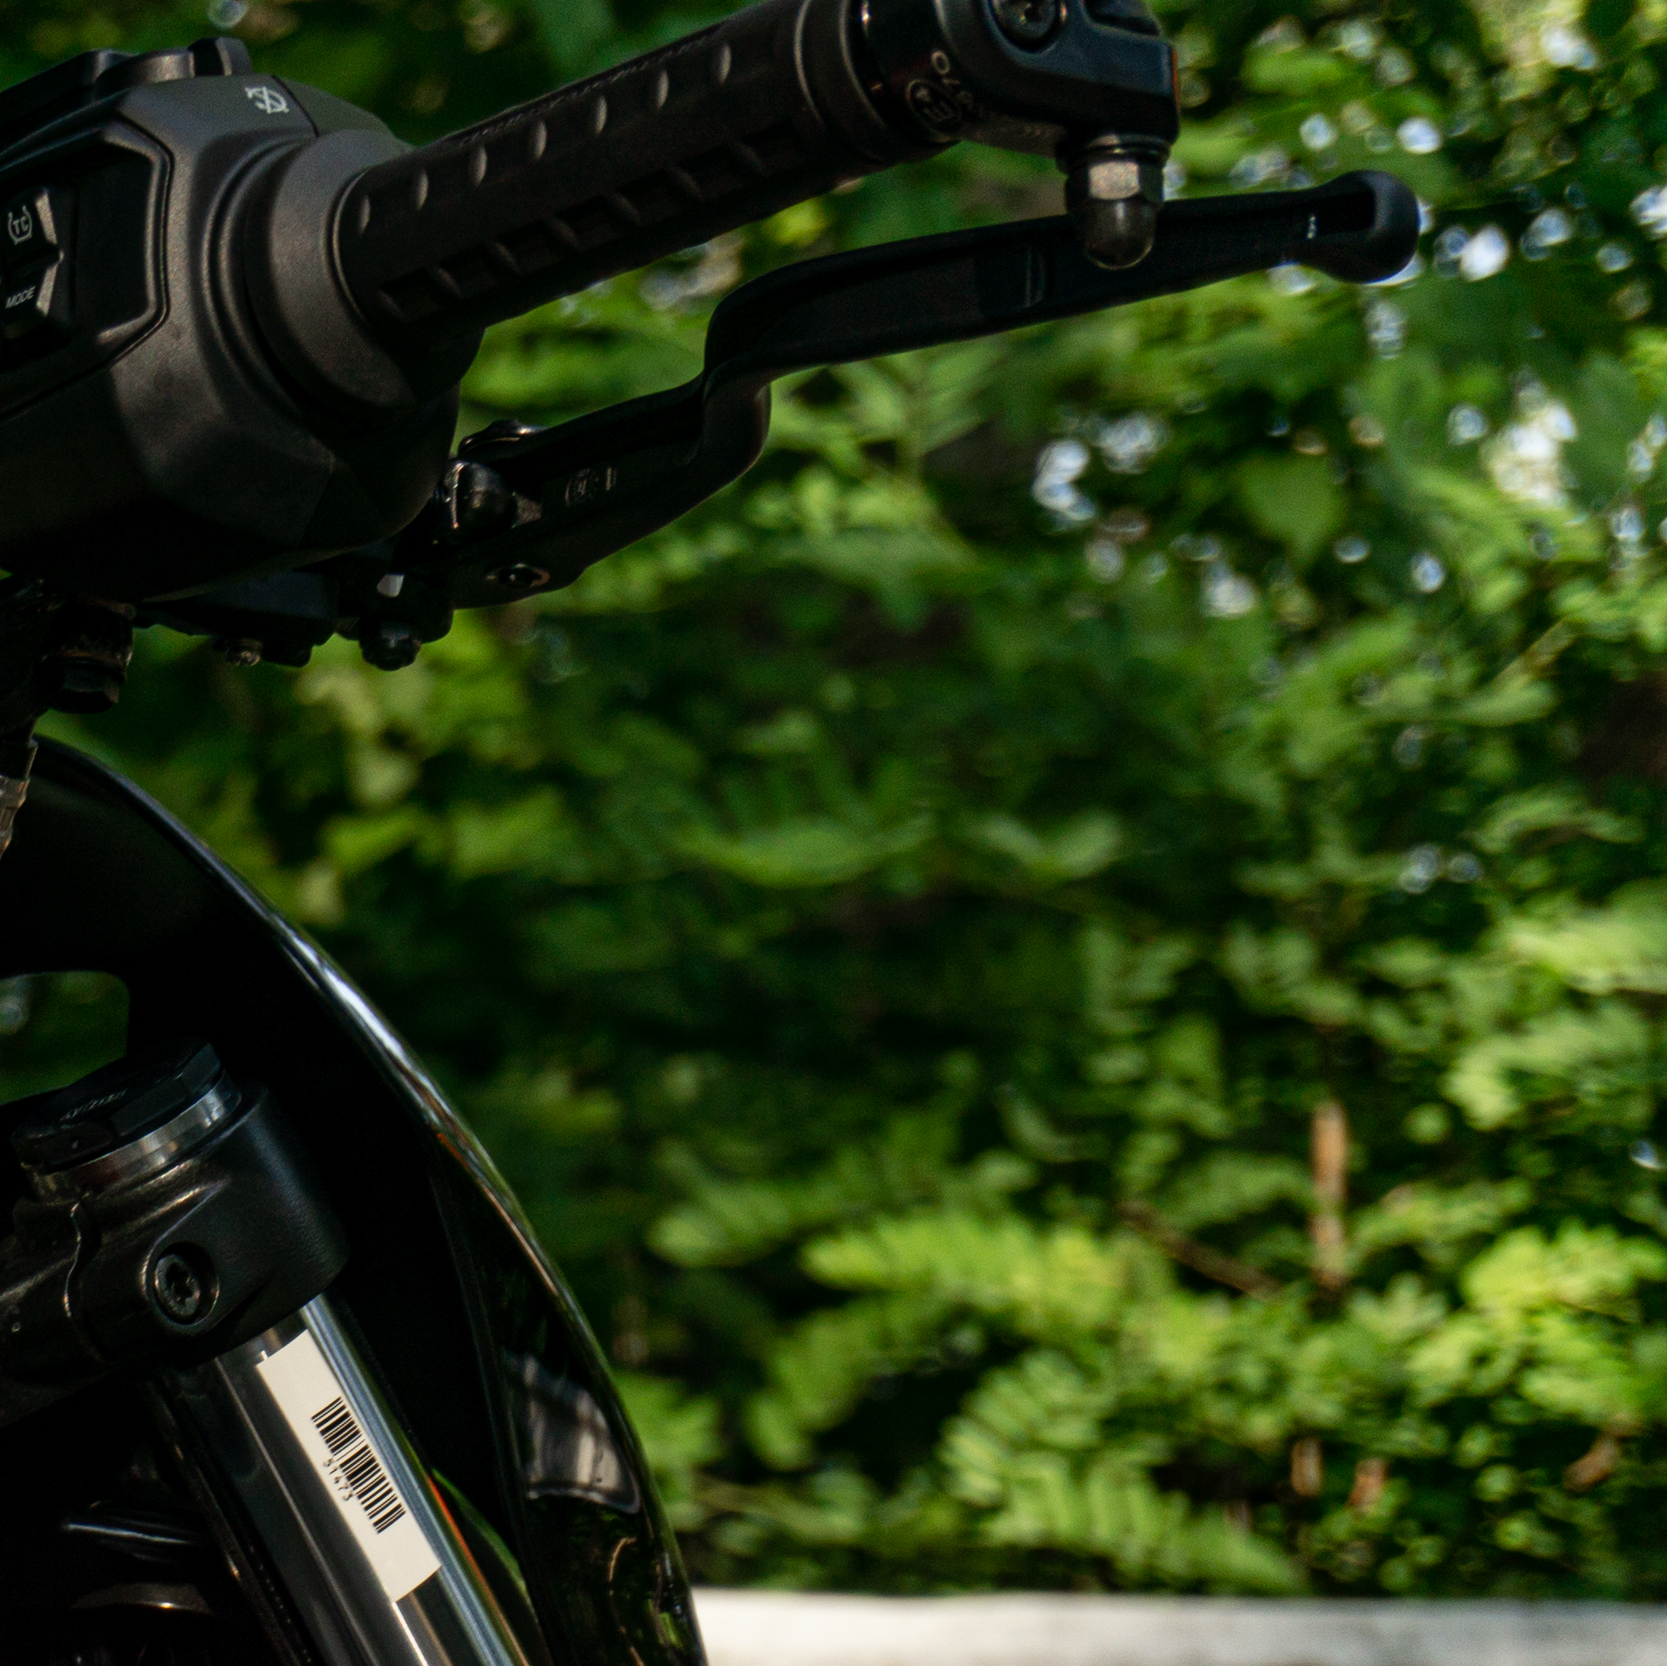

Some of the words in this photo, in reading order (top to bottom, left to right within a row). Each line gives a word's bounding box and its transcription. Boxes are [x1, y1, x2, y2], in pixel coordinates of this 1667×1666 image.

[12, 216, 29, 236] TC
[5, 286, 36, 309] MODE
[322, 1457, 354, 1501] 51473
